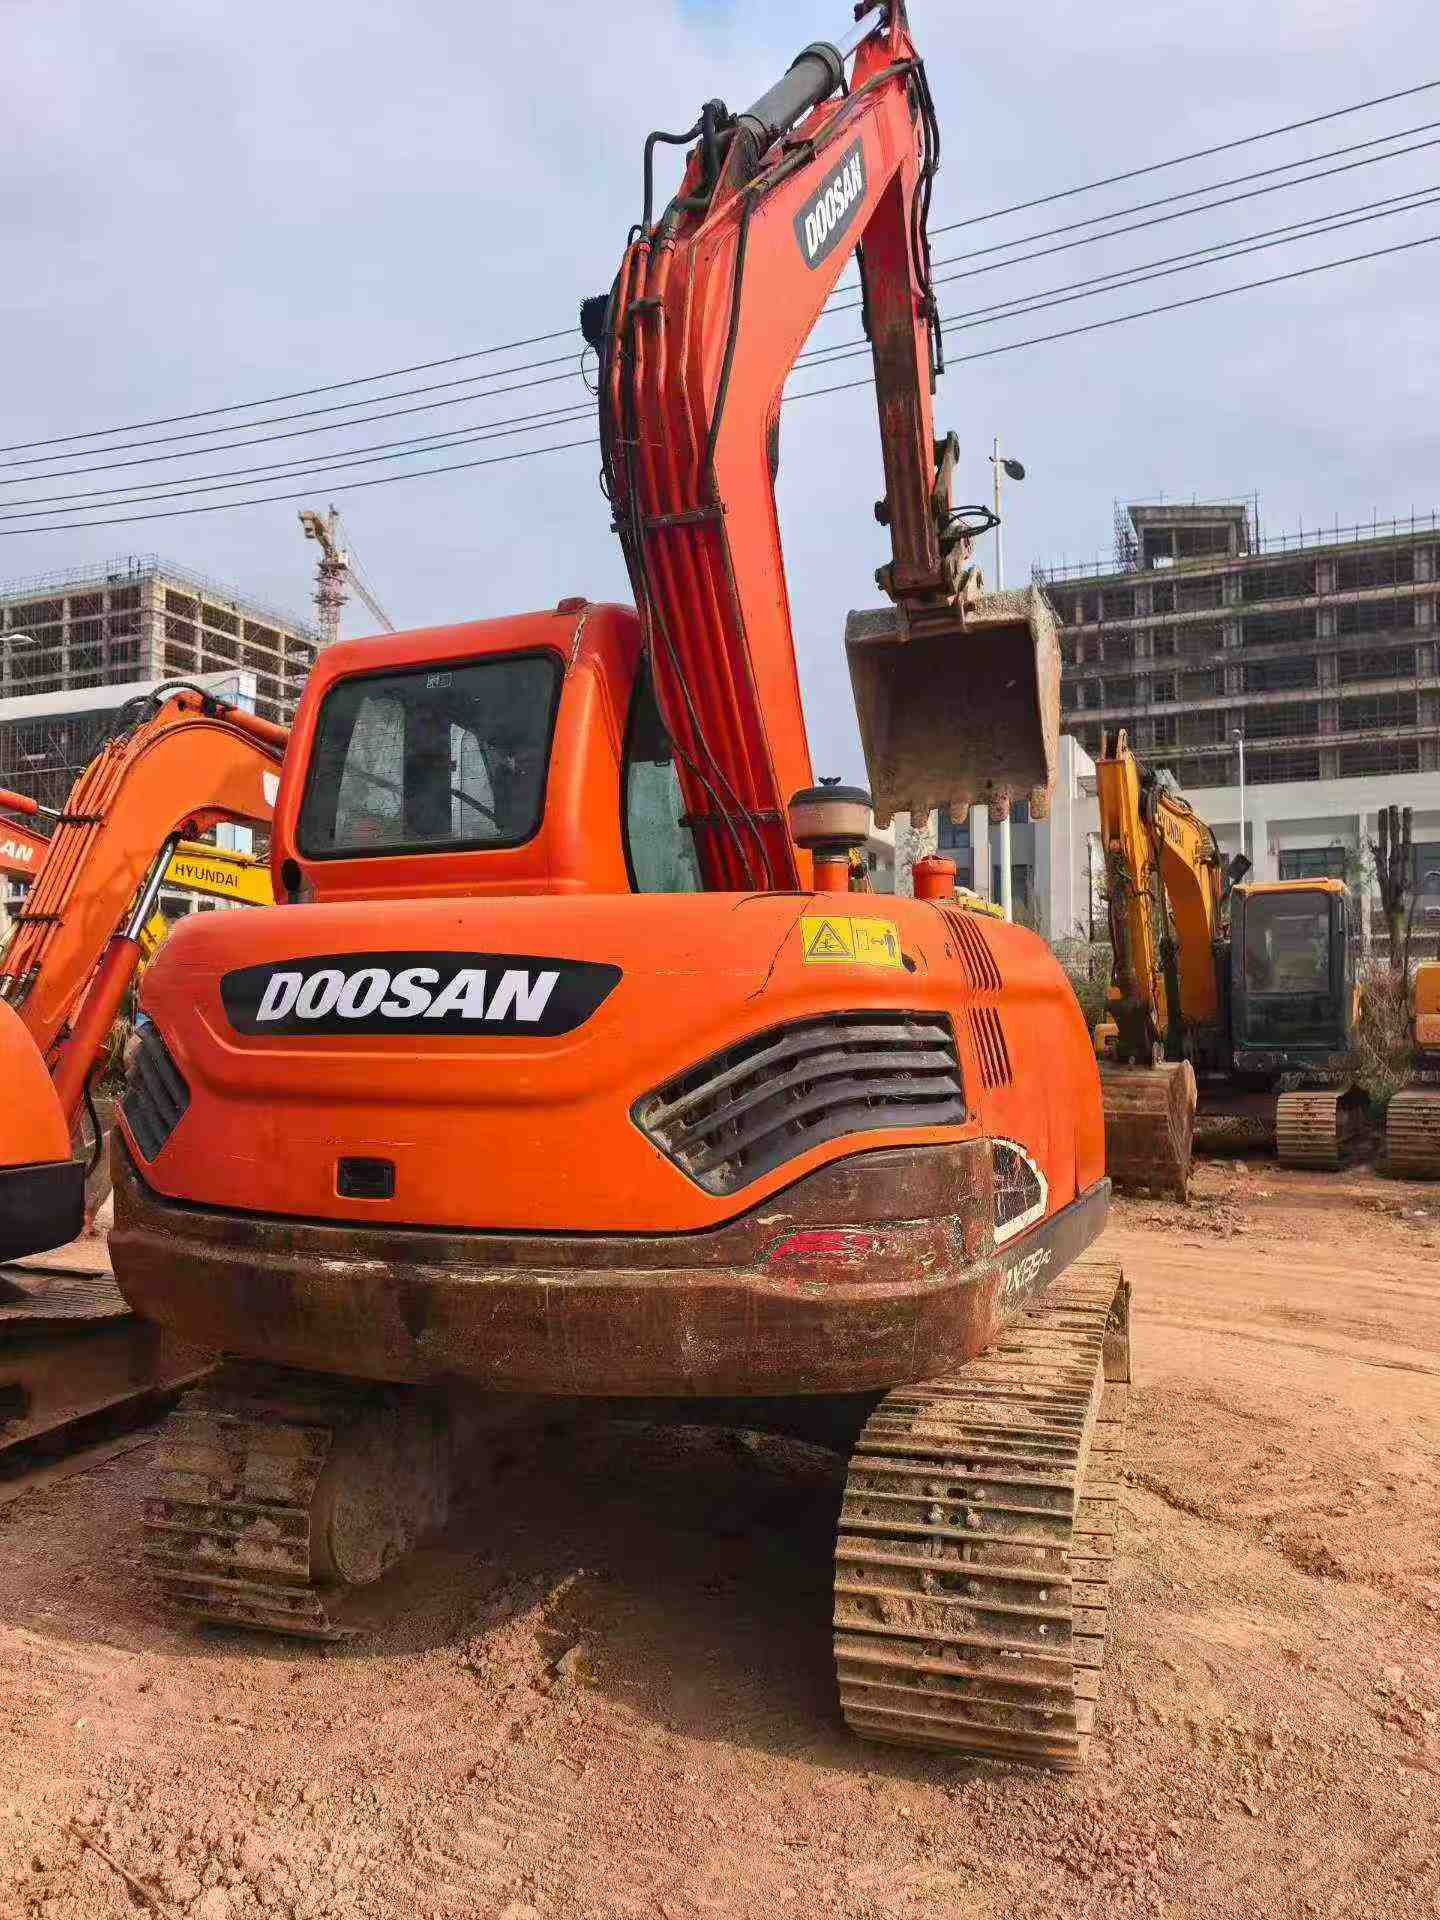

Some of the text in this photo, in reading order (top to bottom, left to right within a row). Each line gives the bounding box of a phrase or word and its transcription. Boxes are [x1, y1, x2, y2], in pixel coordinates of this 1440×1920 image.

[805, 151, 862, 259] DOOSAN
[175, 863, 238, 888] HYUNDAI
[256, 968, 560, 1021] DOOSAN
